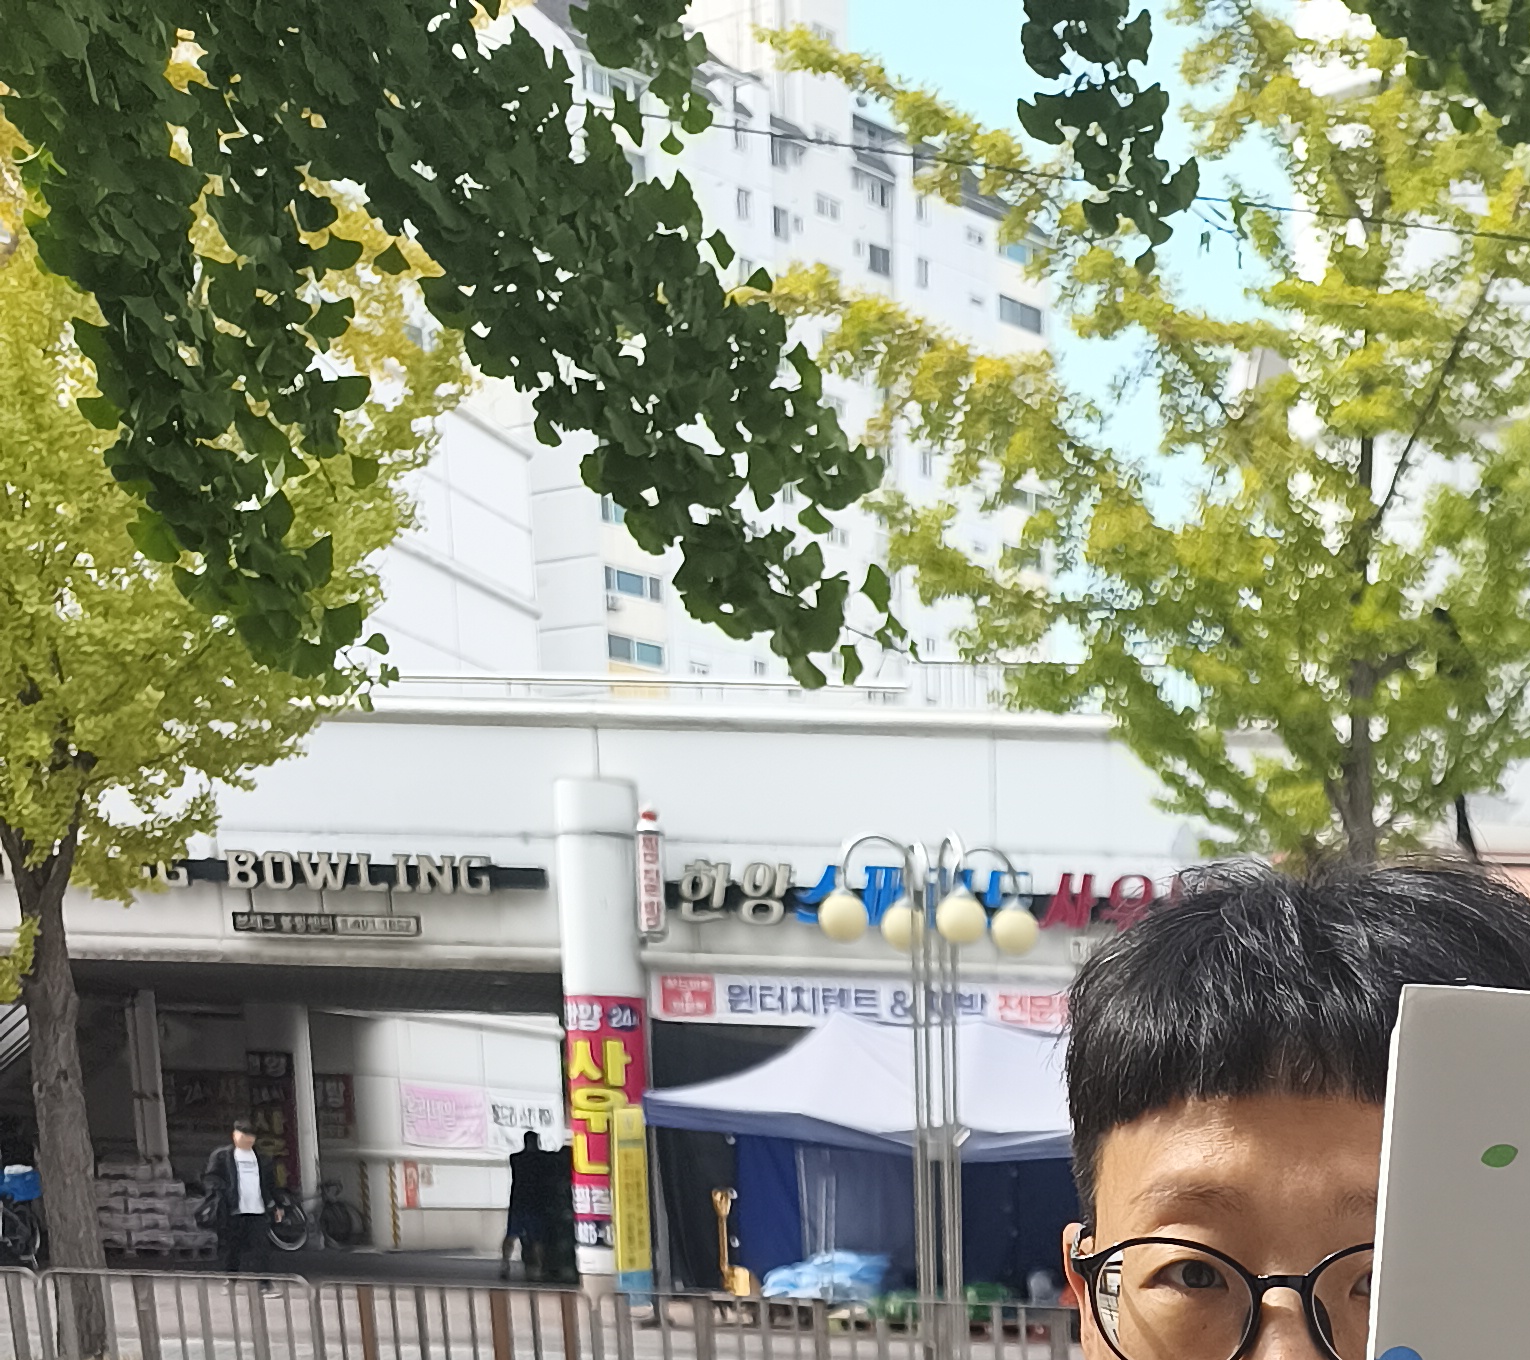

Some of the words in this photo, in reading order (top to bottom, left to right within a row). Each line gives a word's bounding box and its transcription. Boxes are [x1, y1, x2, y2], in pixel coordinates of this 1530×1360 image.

[225, 849, 492, 895] BOWLING
[680, 859, 796, 925] 한양
[998, 993, 1072, 1026] 전문
